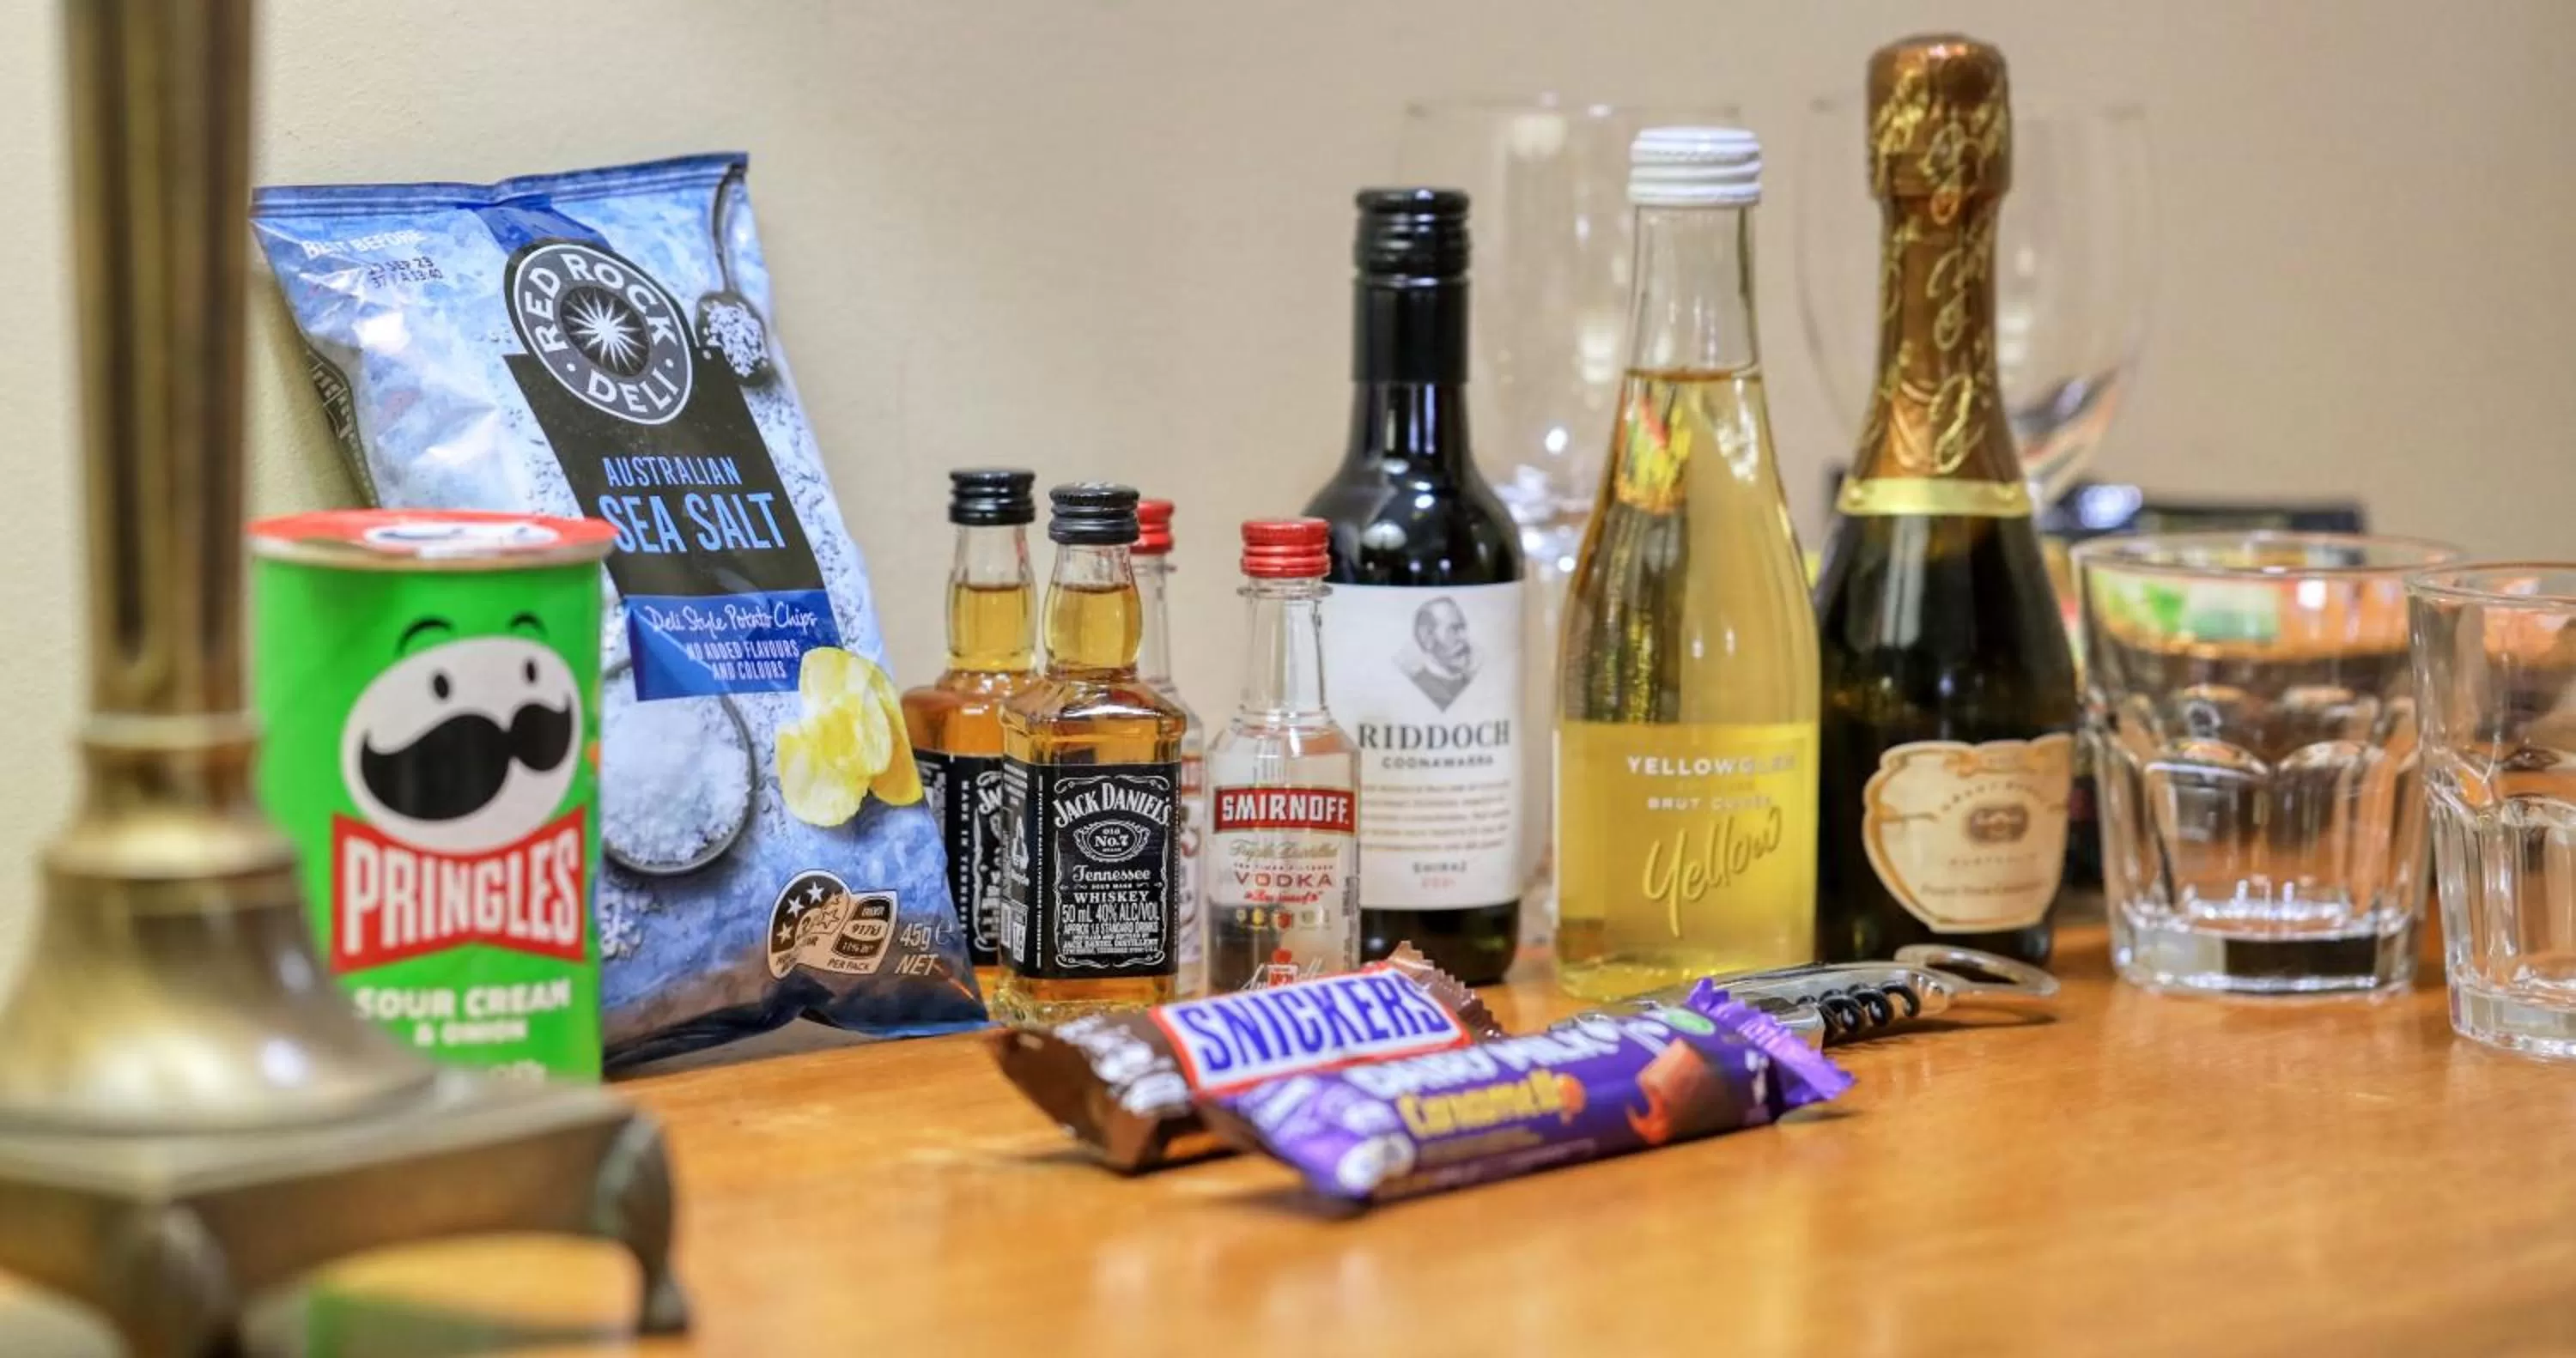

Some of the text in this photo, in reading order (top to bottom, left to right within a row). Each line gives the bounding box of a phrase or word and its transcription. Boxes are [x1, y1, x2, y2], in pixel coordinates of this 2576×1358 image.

[526, 254, 677, 354] RED ROCK
[586, 371, 679, 414] DELI
[602, 455, 742, 488] AUSTRALIAN
[598, 492, 786, 554] SEA SALT
[645, 601, 817, 640] Deli Style Potato Chips
[686, 639, 799, 661] NO ADDED FLAVOURS
[712, 660, 787, 681] AND COLOURS
[1358, 719, 1510, 750] RIDDOCH
[961, 779, 969, 821] MADE
[1052, 782, 1171, 828] JACK DANIEL'S
[1221, 793, 1349, 824] SMIRNOFF
[1647, 796, 1701, 811] BRUT
[960, 829, 969, 847] IN
[1072, 864, 1151, 882] Tennessee
[1235, 870, 1334, 888] VODKA
[1642, 805, 1783, 939] Yellow
[343, 827, 580, 956] PRINGLES
[1073, 890, 1151, 904] WHISKEY
[1061, 904, 1076, 924] 50
[1078, 904, 1094, 923] mL
[902, 922, 932, 950] 45g
[895, 954, 939, 977] NET
[353, 979, 571, 1020] SOUR CREAM
[1177, 971, 1451, 1072] SNICKERS
